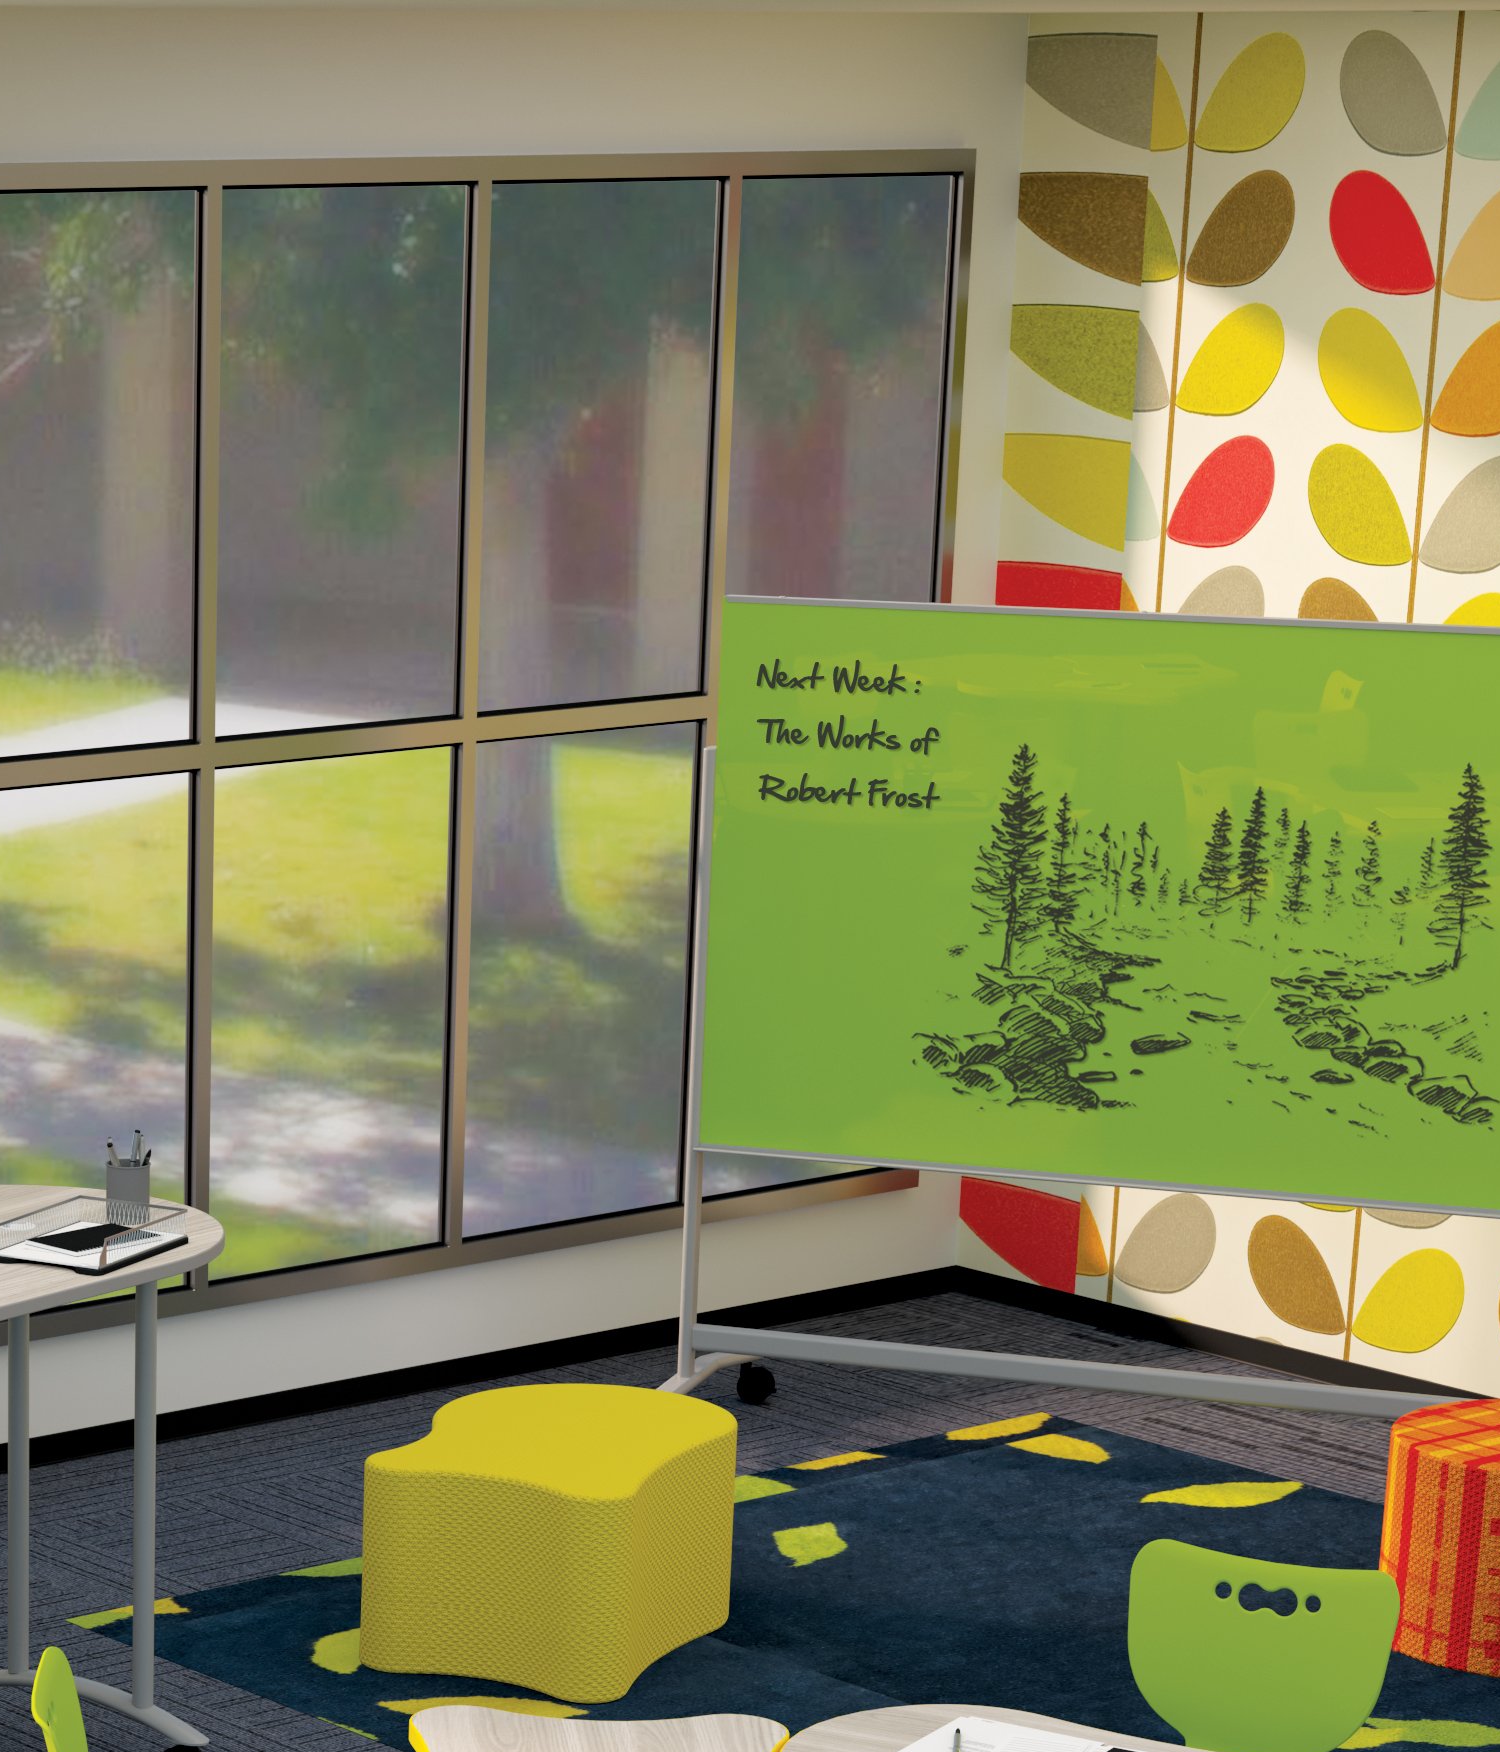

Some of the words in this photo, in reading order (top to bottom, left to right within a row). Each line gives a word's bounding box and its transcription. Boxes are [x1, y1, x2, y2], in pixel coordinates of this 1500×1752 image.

[756, 658, 825, 690] Next
[756, 718, 809, 744] The
[817, 714, 901, 750] Works
[909, 726, 940, 755] of
[758, 772, 862, 805] Robert
[867, 778, 940, 809] Frost
